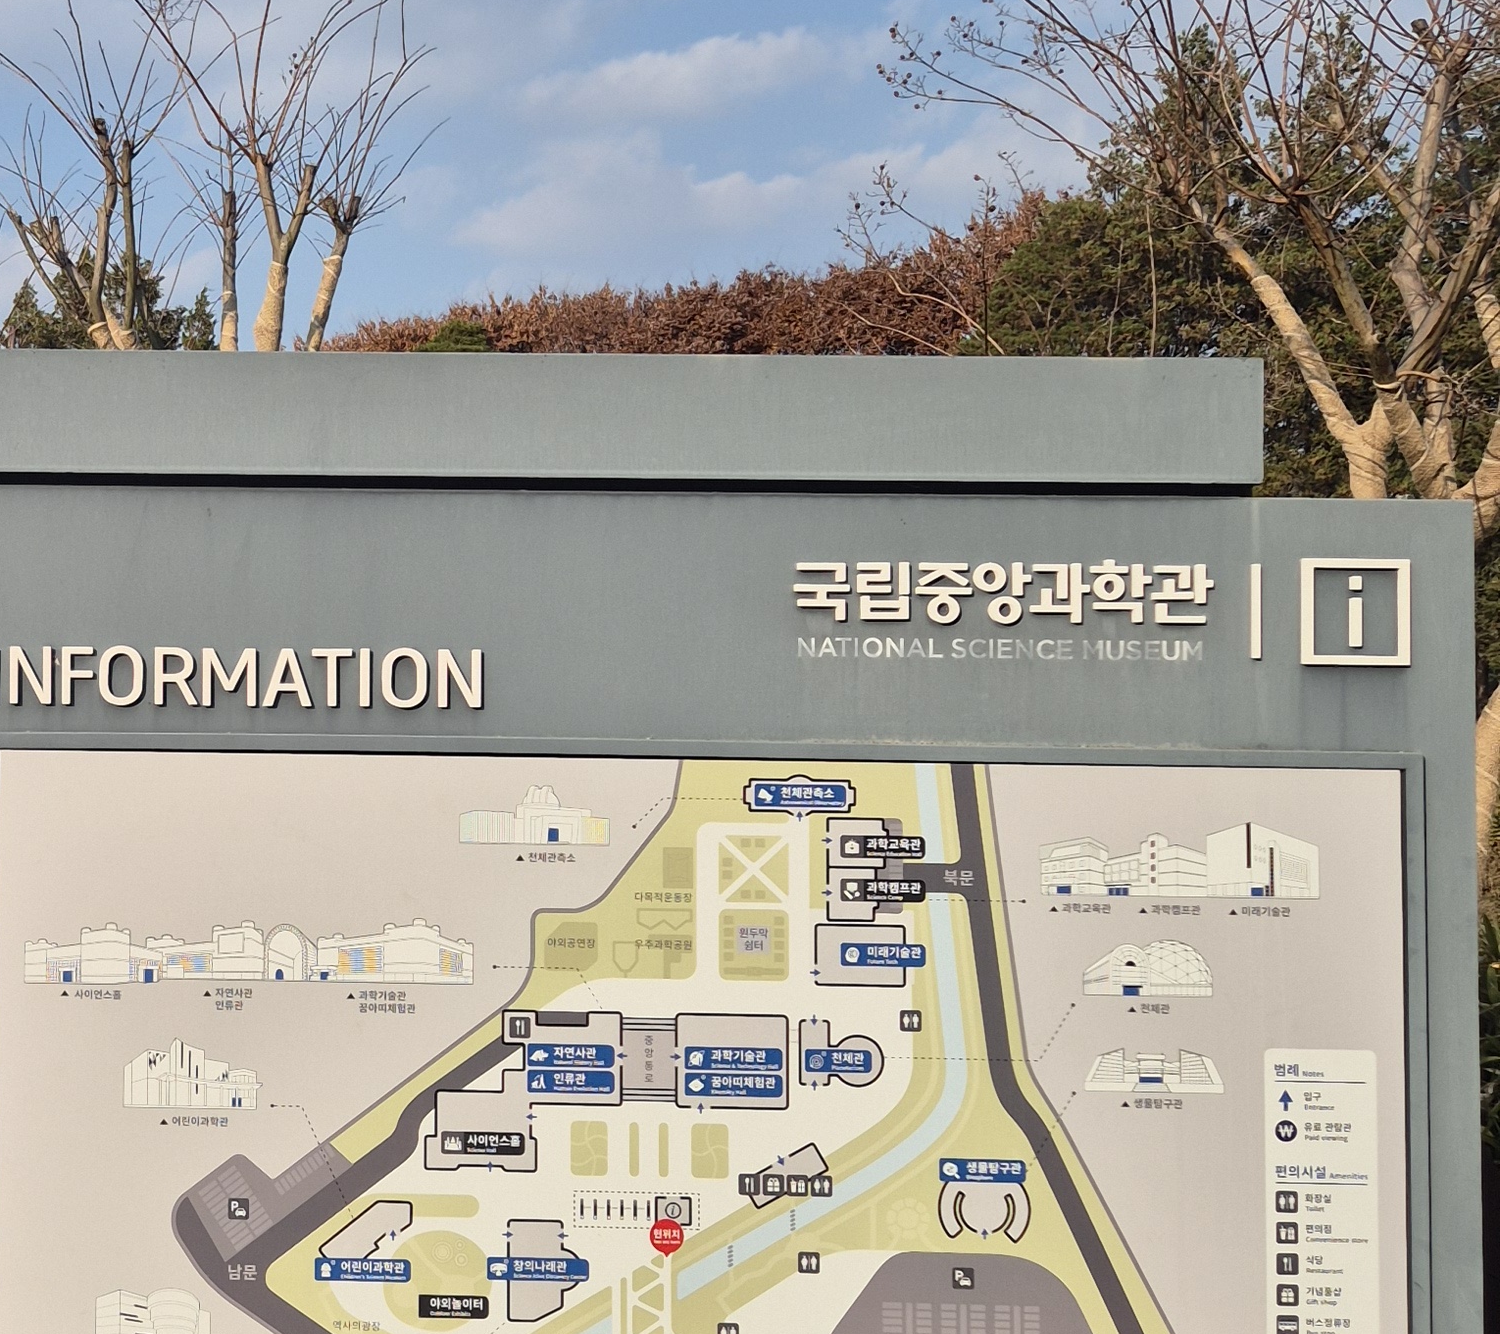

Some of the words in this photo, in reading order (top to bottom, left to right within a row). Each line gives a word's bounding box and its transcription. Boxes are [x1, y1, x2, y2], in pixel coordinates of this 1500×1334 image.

[792, 559, 1214, 625] 국립중앙과학관
[798, 636, 944, 659] NATIONAL
[951, 638, 1073, 660] SCIENCE
[1082, 640, 1204, 661] MUSEUM
[867, 839, 921, 851] 과학교육관
[943, 869, 975, 887] 북문
[867, 882, 921, 894] 과학캠프관
[634, 892, 692, 903] 다목적운동장
[1241, 906, 1291, 918] 미래기술관
[739, 927, 768, 939] 원두막
[547, 938, 595, 948] 야외공연장
[744, 941, 764, 951] 쉼터
[867, 946, 922, 959] 미래기술관
[74, 988, 122, 1001] 사이언스홀
[215, 986, 253, 999] 자연사관
[359, 991, 406, 1001] 과학기술관
[215, 999, 244, 1011] 인류관
[553, 1047, 596, 1059] 자연사관
[711, 1050, 766, 1062] 과학기술관
[831, 1052, 865, 1064] 천체관
[1274, 1063, 1299, 1077] 범례
[553, 1073, 586, 1085] 인류관
[171, 1115, 229, 1128] 어린이과학관
[467, 1134, 520, 1147] 사이언스홀
[1275, 1165, 1326, 1179] 편의시설
[513, 1259, 568, 1273] 창의나래관
[1306, 1256, 1323, 1265] 식당
[228, 1263, 258, 1281] 남문
[340, 1260, 405, 1274] 어린이과학관
[430, 1297, 483, 1311] 야외놀이터
